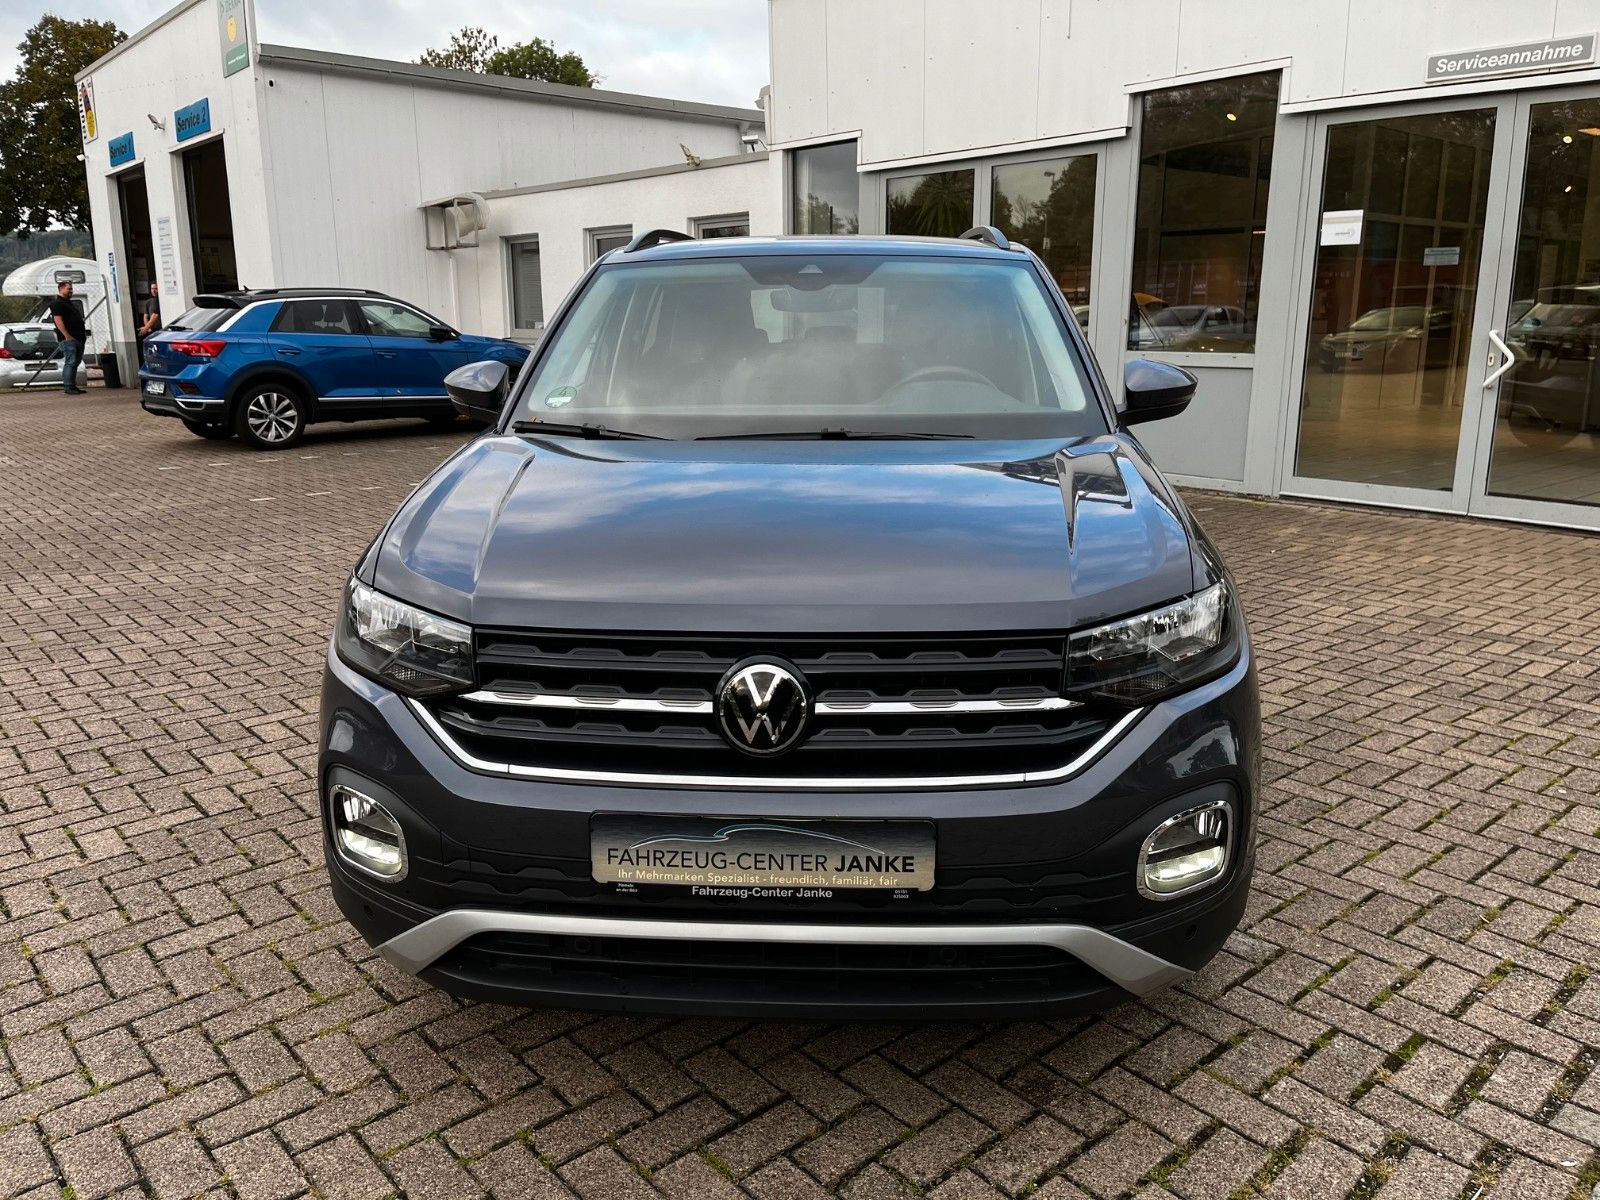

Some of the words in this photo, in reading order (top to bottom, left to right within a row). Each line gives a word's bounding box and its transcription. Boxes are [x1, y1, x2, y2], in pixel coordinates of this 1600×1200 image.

[1435, 44, 1583, 73] Serviceannahme
[177, 111, 200, 132] Service
[110, 142, 127, 159] Service
[607, 848, 828, 871] FAHRZEUG-CENTER
[834, 855, 915, 873] JANKE
[618, 869, 632, 880] Ihr
[636, 869, 704, 882] Mehrmarken
[707, 872, 759, 885] Spezialist
[770, 874, 828, 886] freundlich,
[832, 875, 876, 887] familiär,
[879, 876, 897, 886] fair
[692, 886, 793, 898] Fahrzeug-Center
[796, 887, 832, 898] Janke
